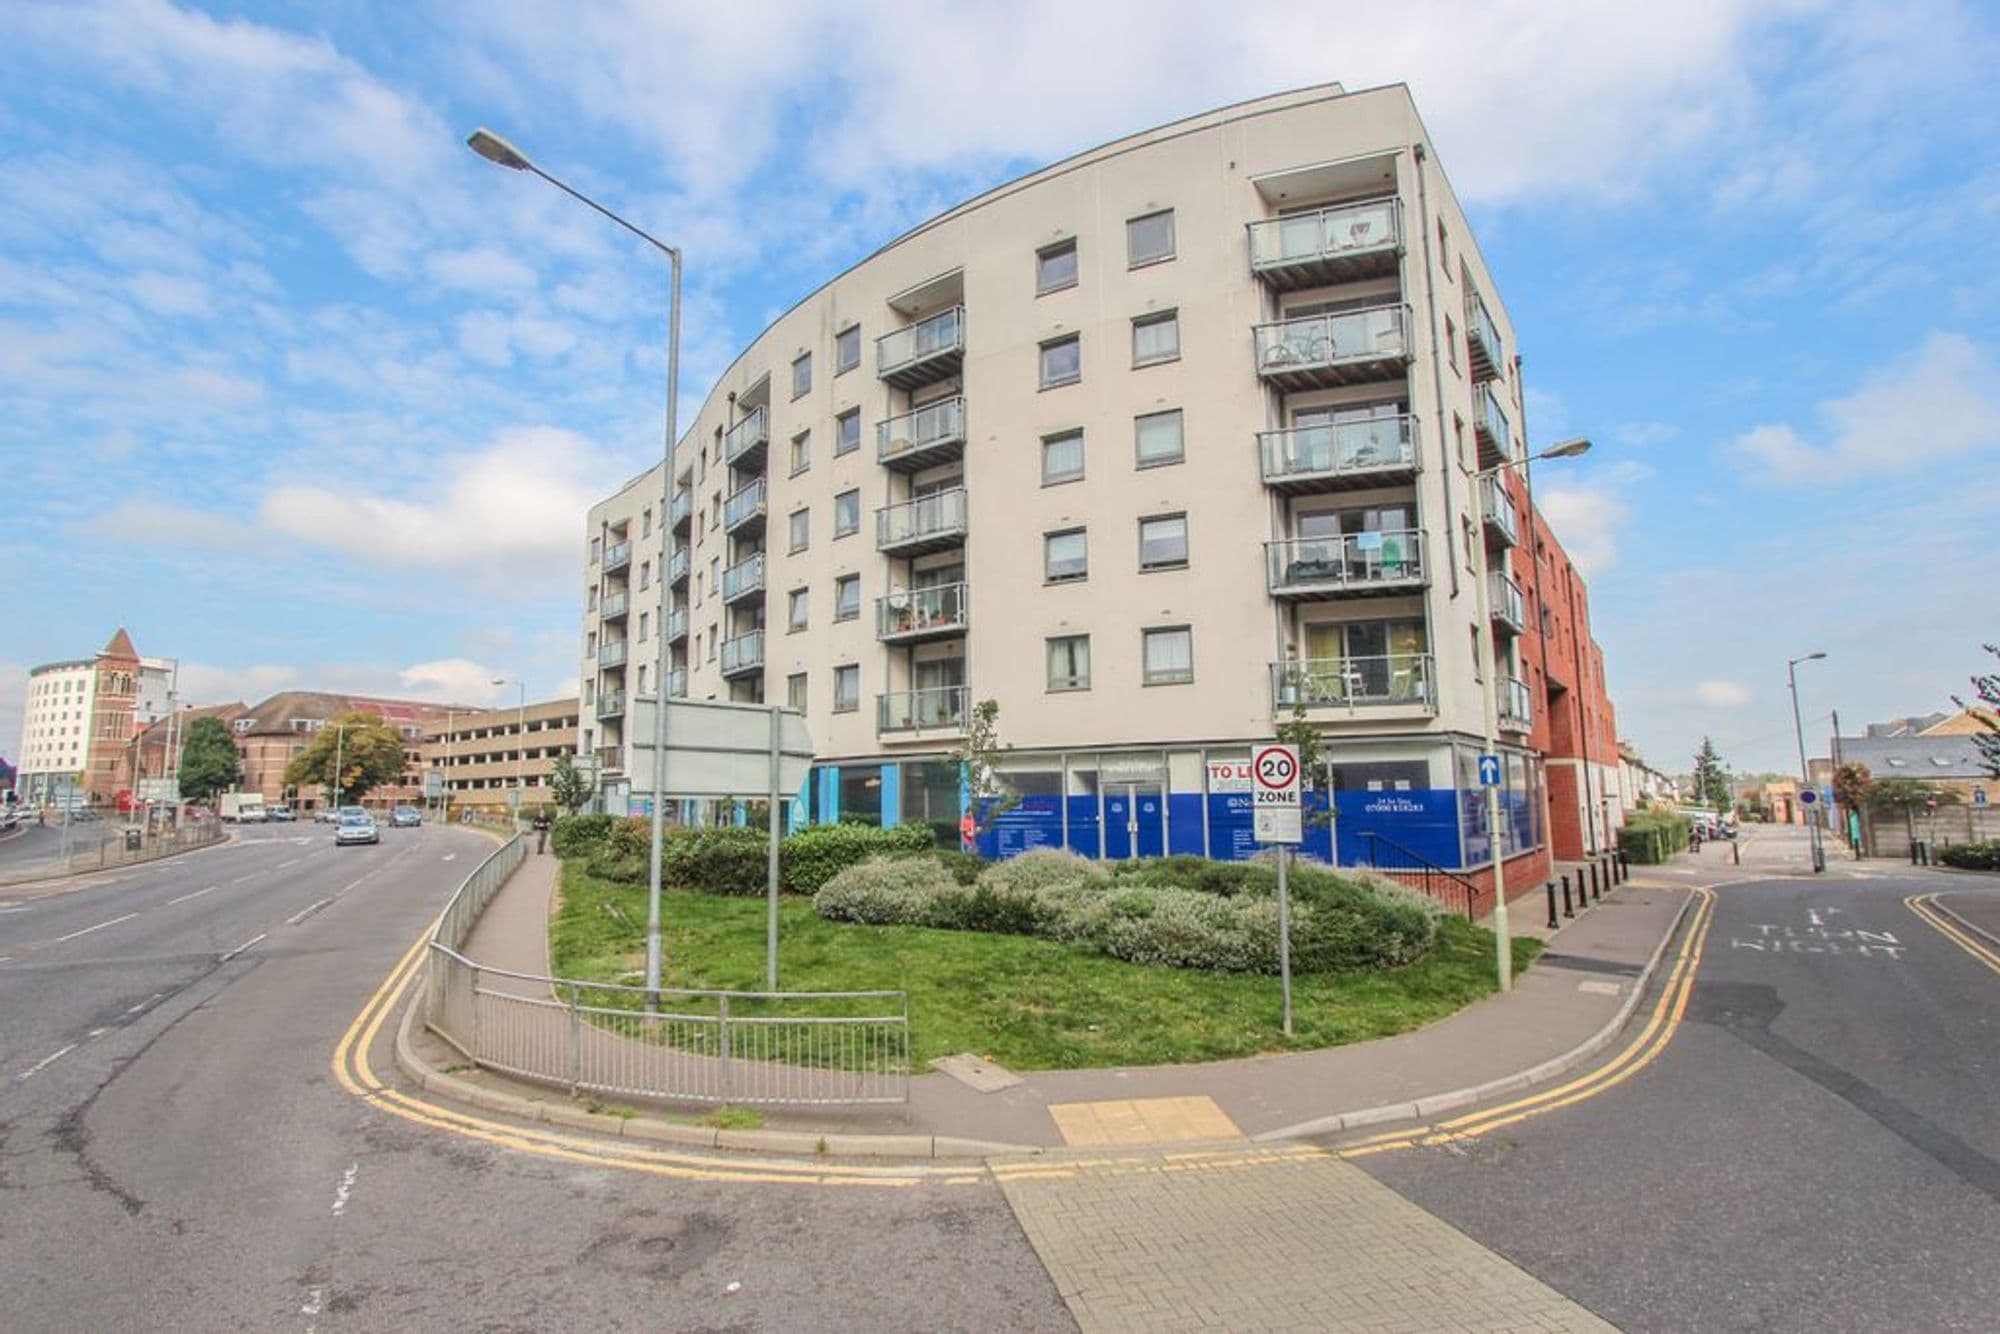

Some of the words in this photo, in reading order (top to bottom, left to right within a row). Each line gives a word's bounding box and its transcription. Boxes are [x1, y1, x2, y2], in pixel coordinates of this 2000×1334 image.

[1210, 766, 1232, 779] TO
[1262, 760, 1290, 777] 20
[1257, 791, 1297, 803] ZONE
